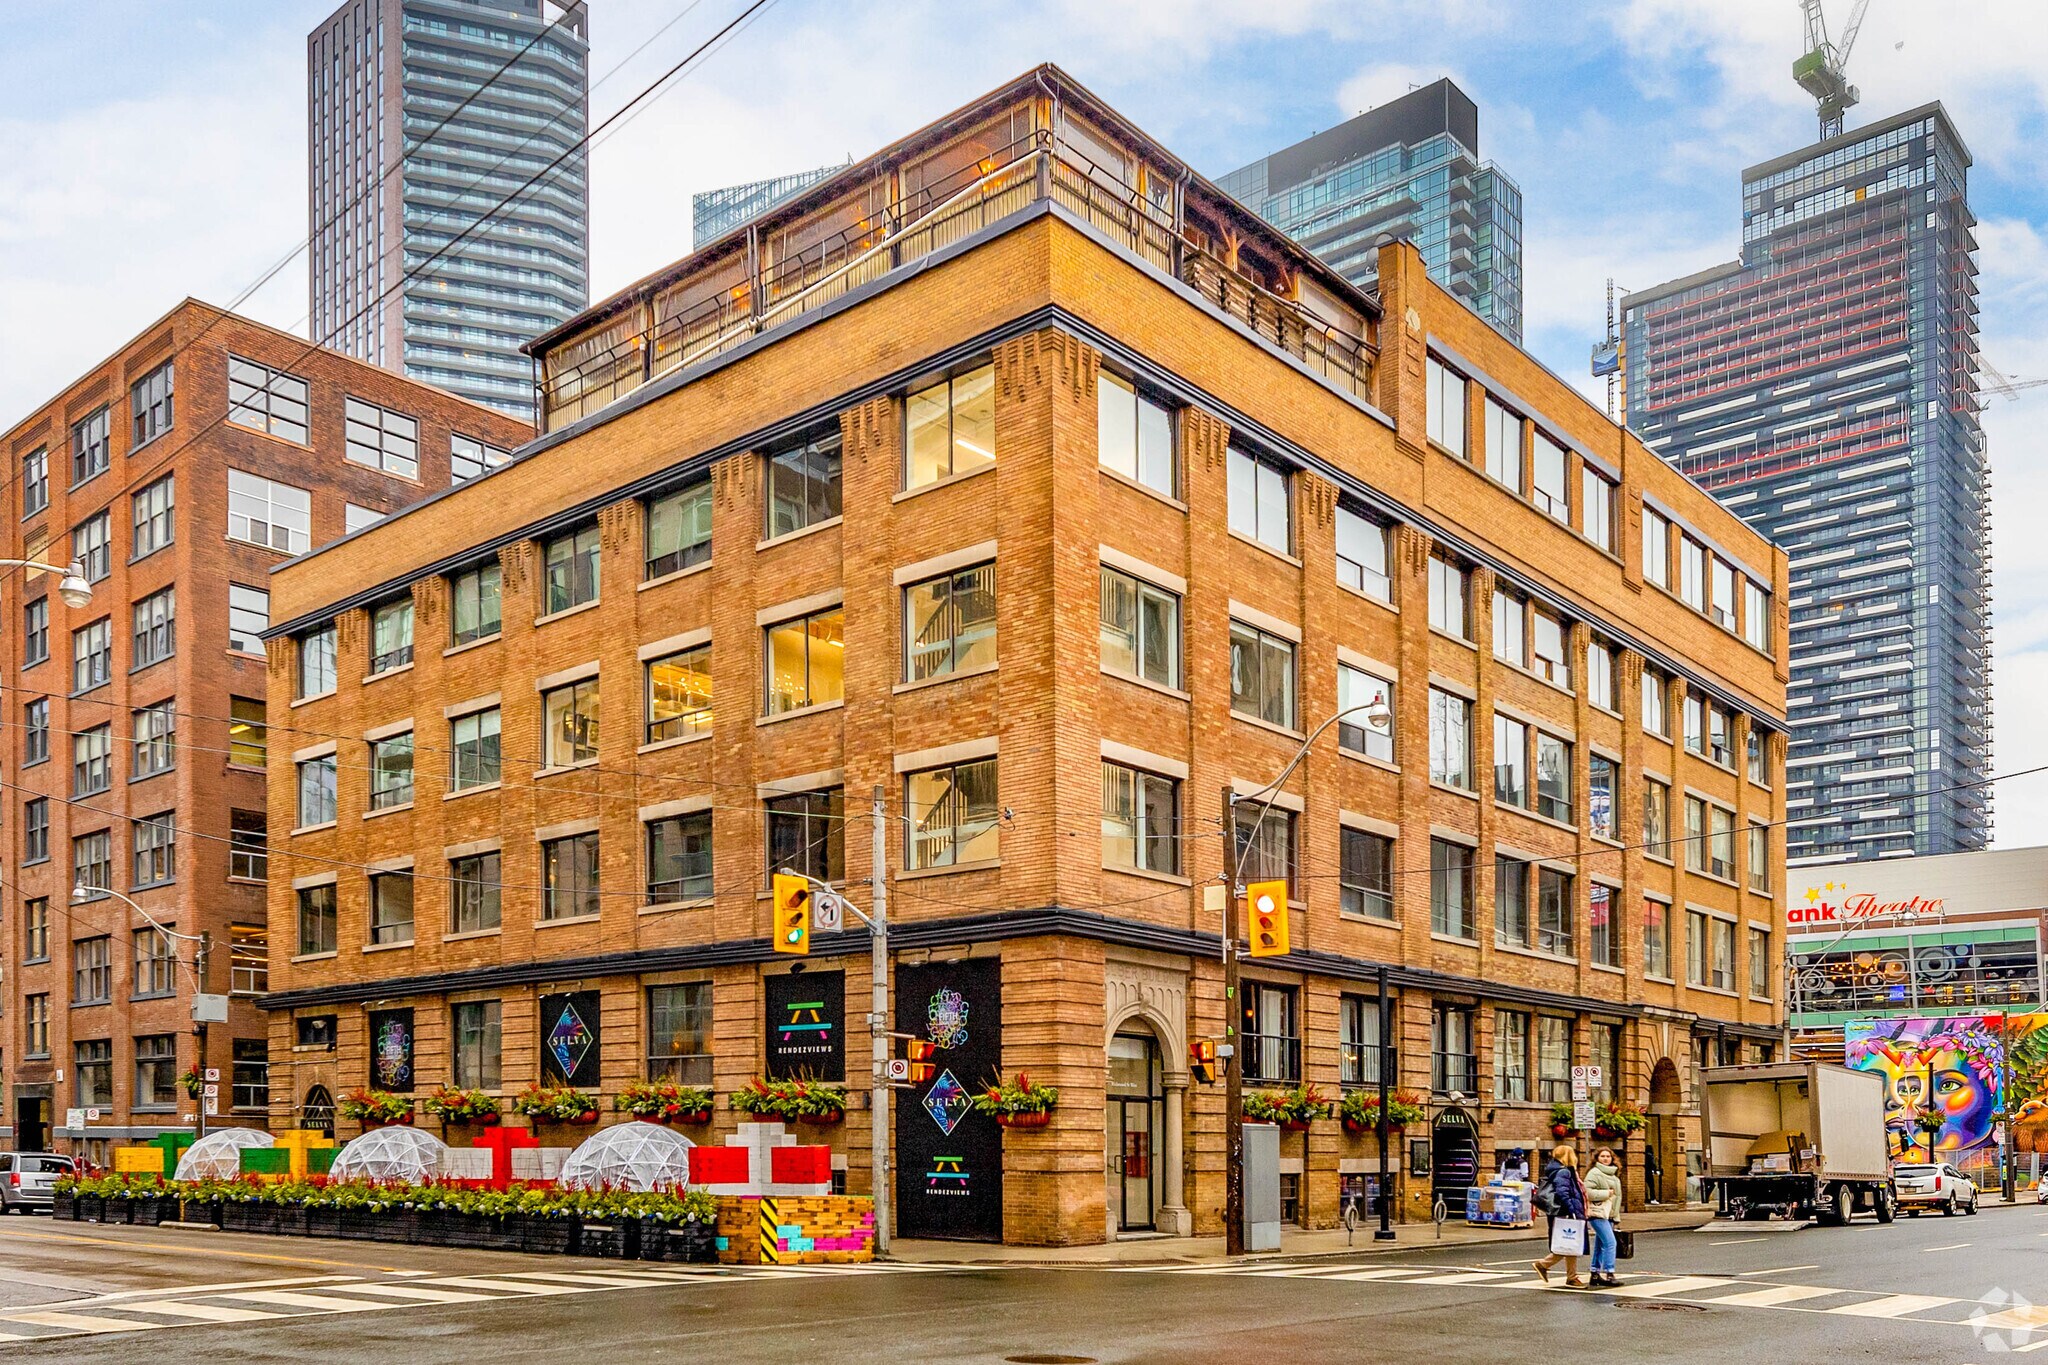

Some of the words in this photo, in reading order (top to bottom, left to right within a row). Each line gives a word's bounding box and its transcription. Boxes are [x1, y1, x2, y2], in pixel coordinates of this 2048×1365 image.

[1840, 892, 1944, 919] Theatre
[552, 1035, 587, 1046] SELVA
[778, 1045, 832, 1054] RENDEZVIEWS
[928, 1097, 967, 1107] SELVA
[1442, 1114, 1465, 1124] SELVA
[926, 1188, 970, 1196] RENDEZVIEWS
